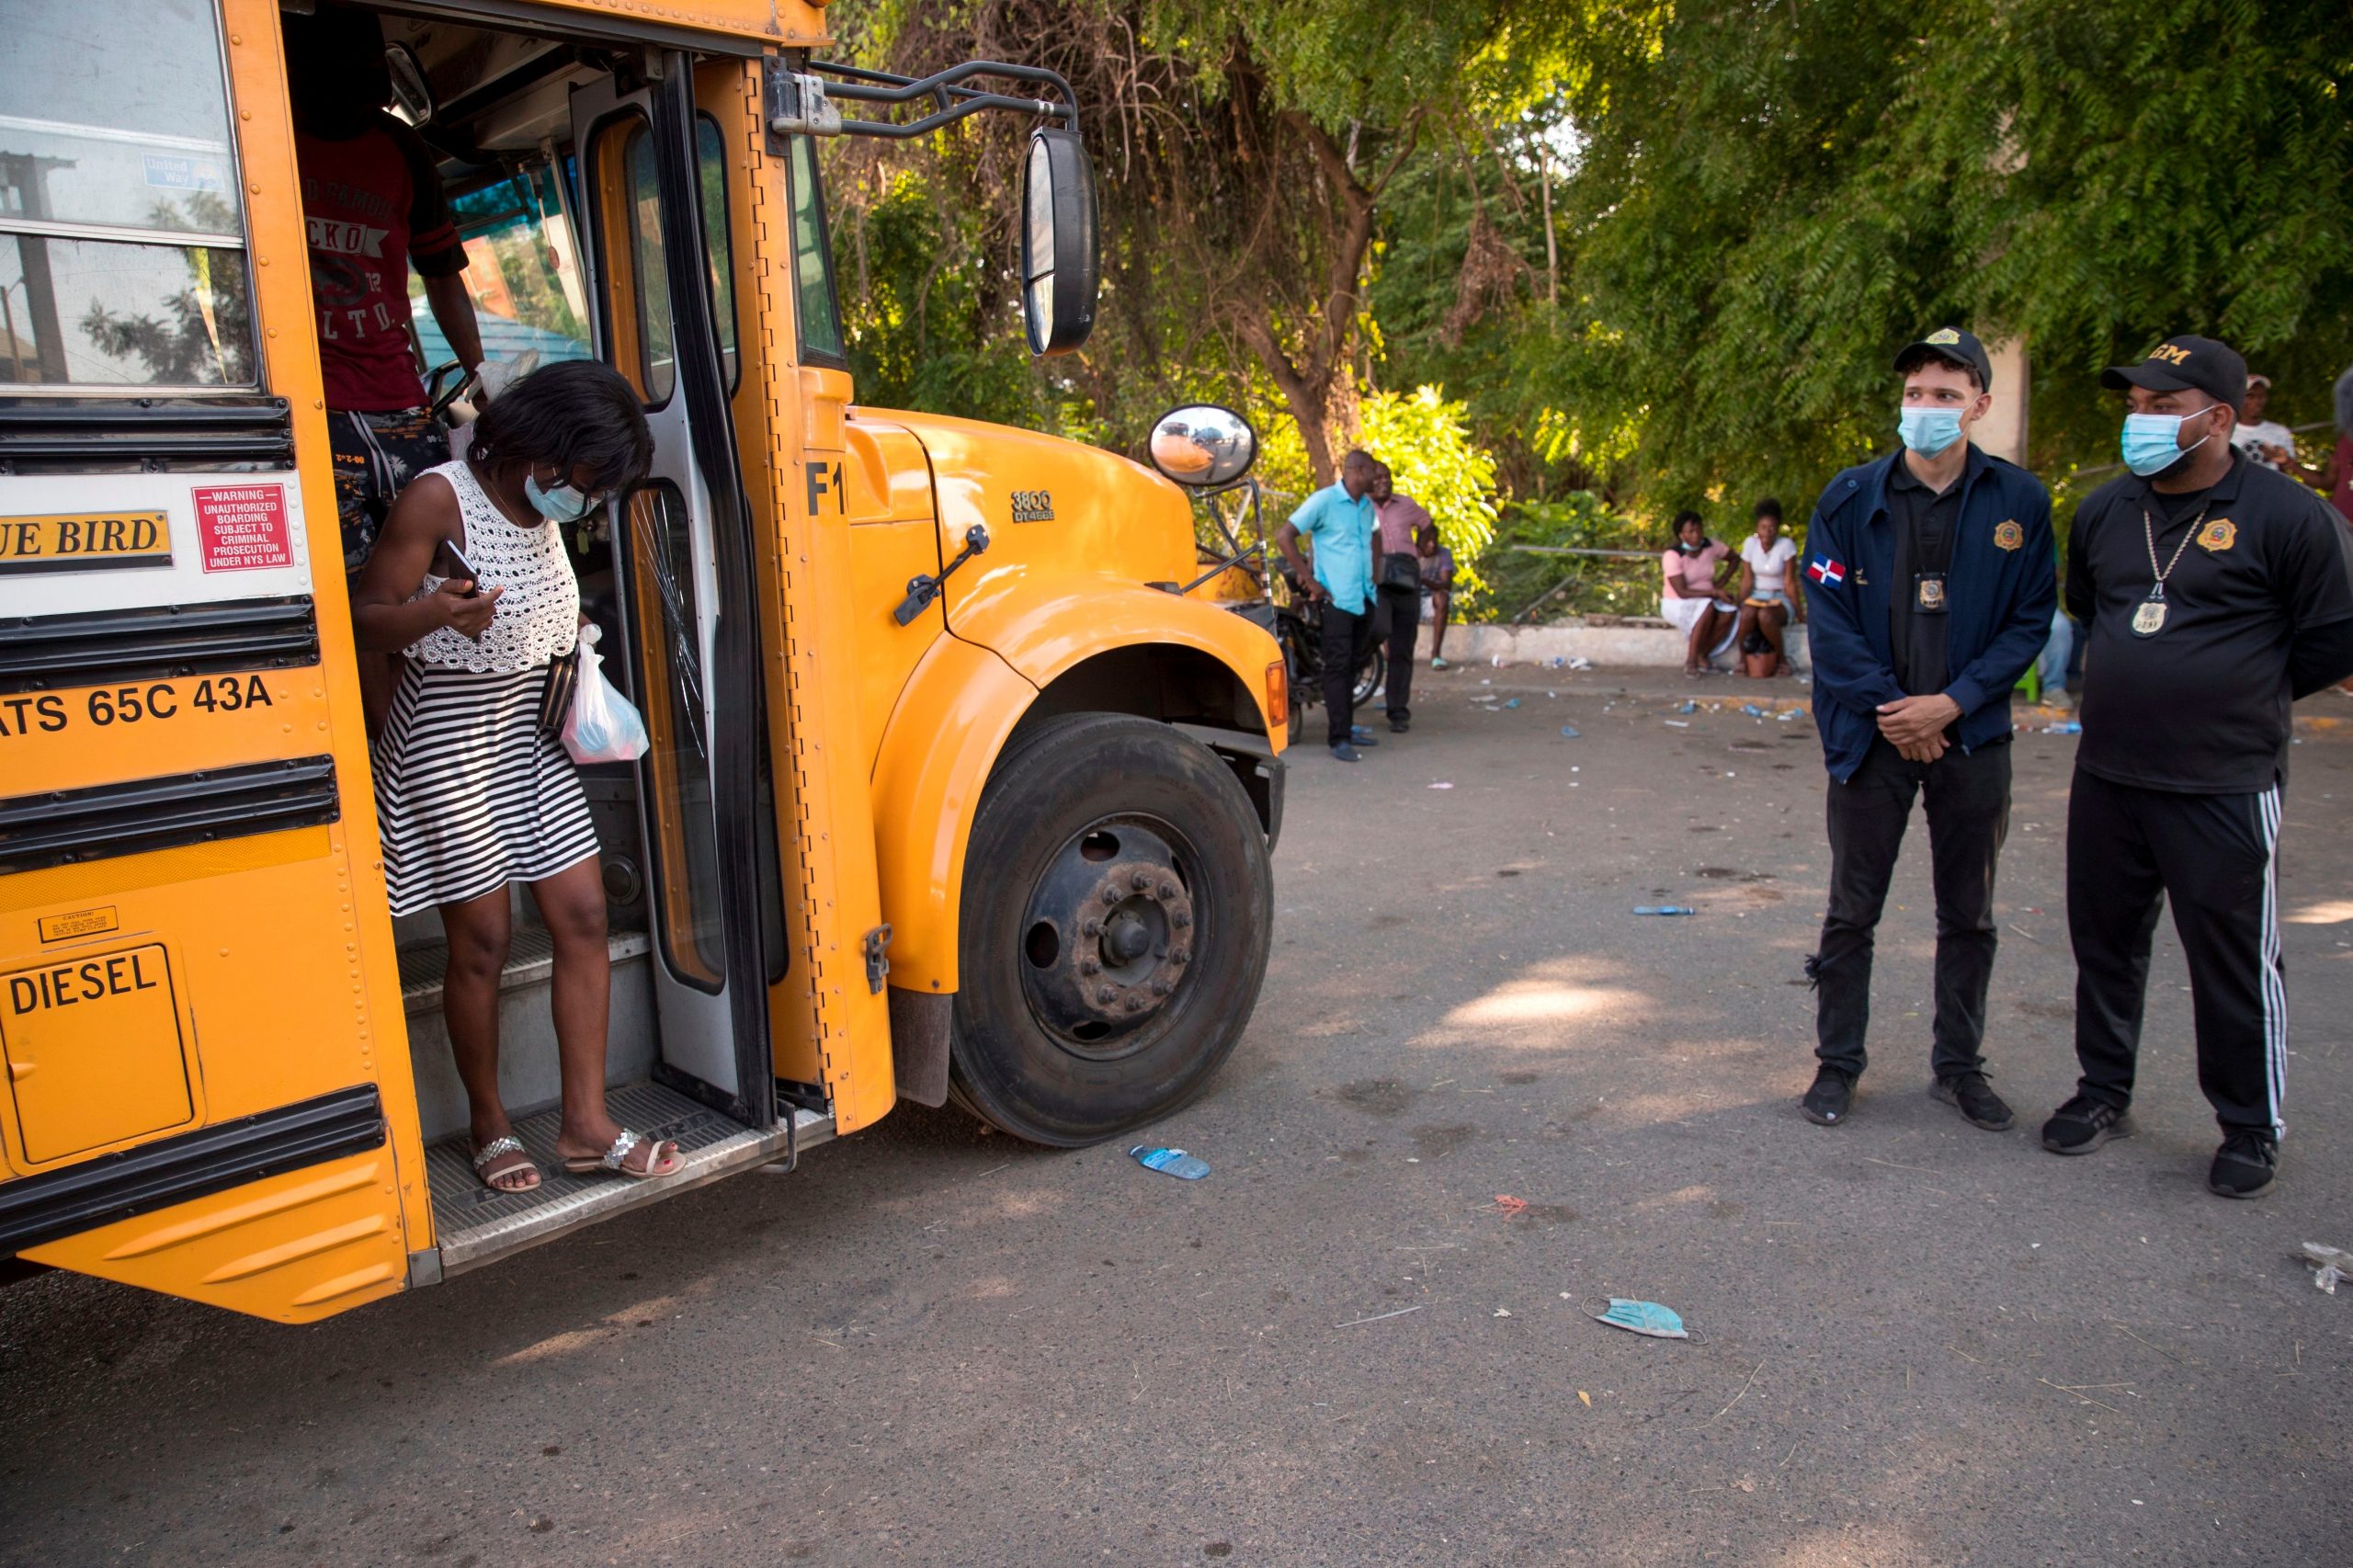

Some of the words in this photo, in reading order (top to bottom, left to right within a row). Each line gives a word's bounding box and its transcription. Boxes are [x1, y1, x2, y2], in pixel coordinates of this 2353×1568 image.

[147, 159, 188, 172] United
[164, 171, 189, 186] Way
[326, 182, 394, 222] FAMOU
[323, 301, 396, 340] LTD.
[211, 490, 265, 502] WARNING
[806, 461, 845, 516] F1
[204, 502, 278, 515] UNAUTHORIZED
[1011, 490, 1051, 512] 3800
[217, 513, 268, 524] BOARDING
[56, 518, 157, 553] BIRD
[214, 524, 256, 535] SUBJECT
[260, 522, 273, 532] TO
[221, 534, 269, 545] CRIMINAL
[213, 543, 279, 556] PROSECUTION
[210, 556, 241, 568] UNDER
[244, 555, 264, 565] NYS
[266, 553, 286, 563] LAW
[88, 684, 177, 726] 65C
[193, 675, 273, 713] 43A
[10, 955, 156, 1015] DIESEL
